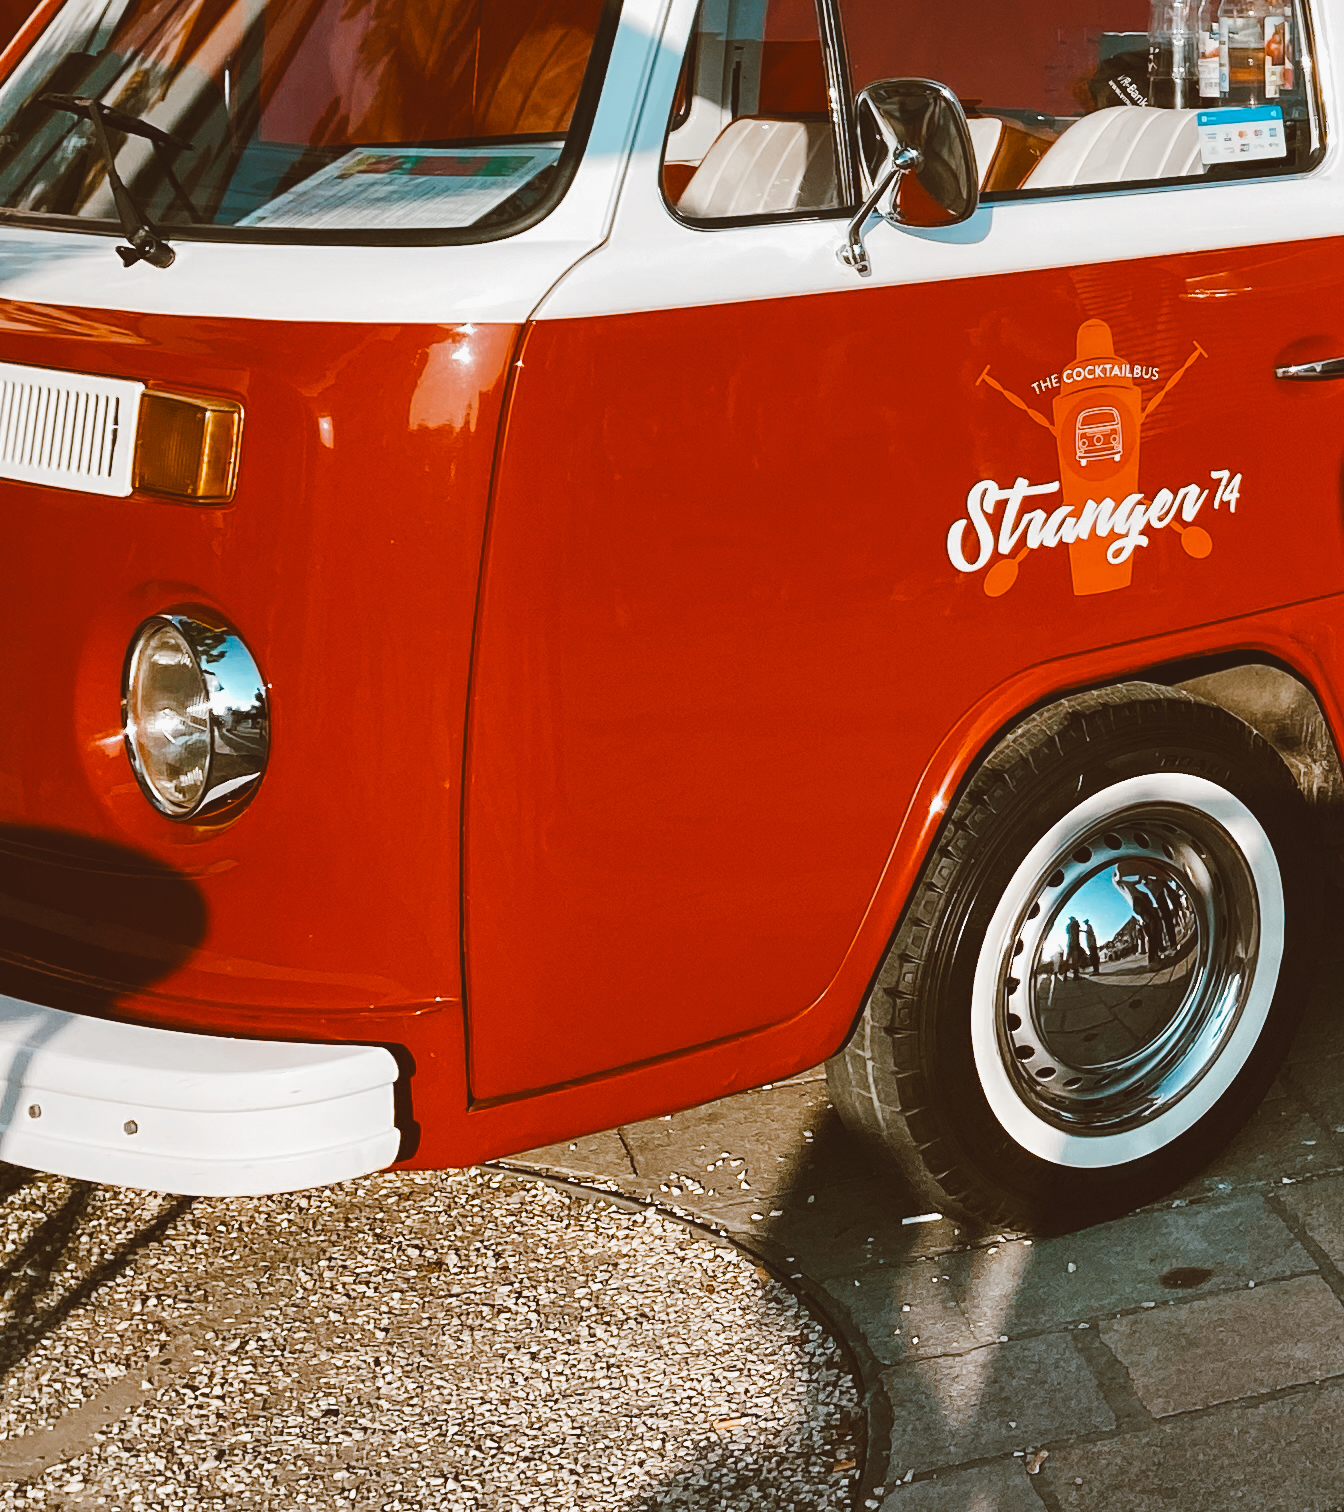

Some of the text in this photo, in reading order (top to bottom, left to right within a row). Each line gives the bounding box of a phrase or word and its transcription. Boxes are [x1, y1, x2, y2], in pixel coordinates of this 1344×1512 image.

[1031, 362, 1160, 395] THE COCKTAILBUS
[947, 469, 1243, 573] Stranger 74
